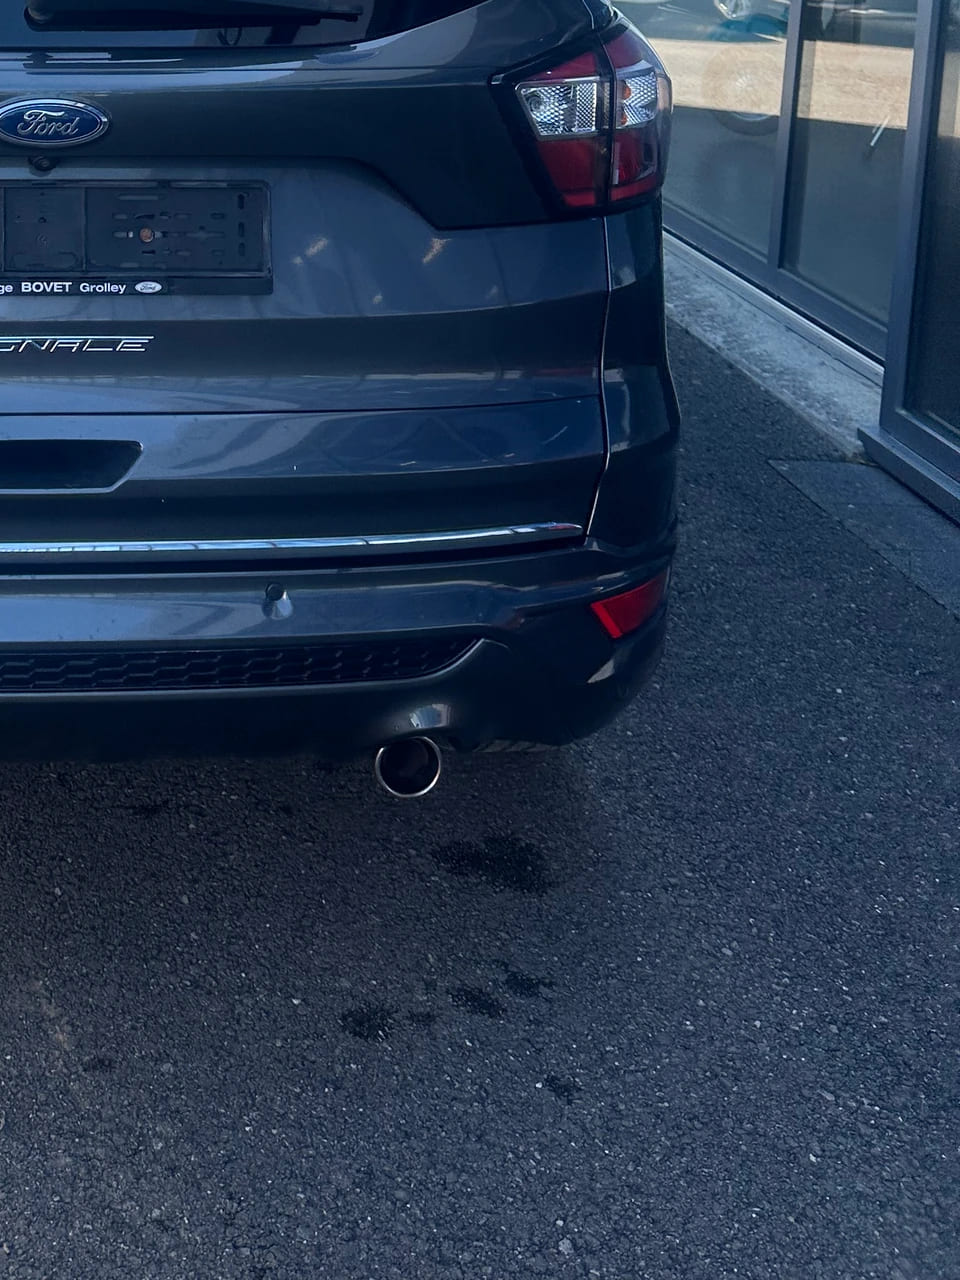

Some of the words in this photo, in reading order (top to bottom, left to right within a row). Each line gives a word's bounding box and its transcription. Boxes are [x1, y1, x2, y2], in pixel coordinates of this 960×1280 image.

[17, 109, 81, 136] Ford
[21, 281, 73, 293] BOVET
[79, 282, 127, 295] Grolley
